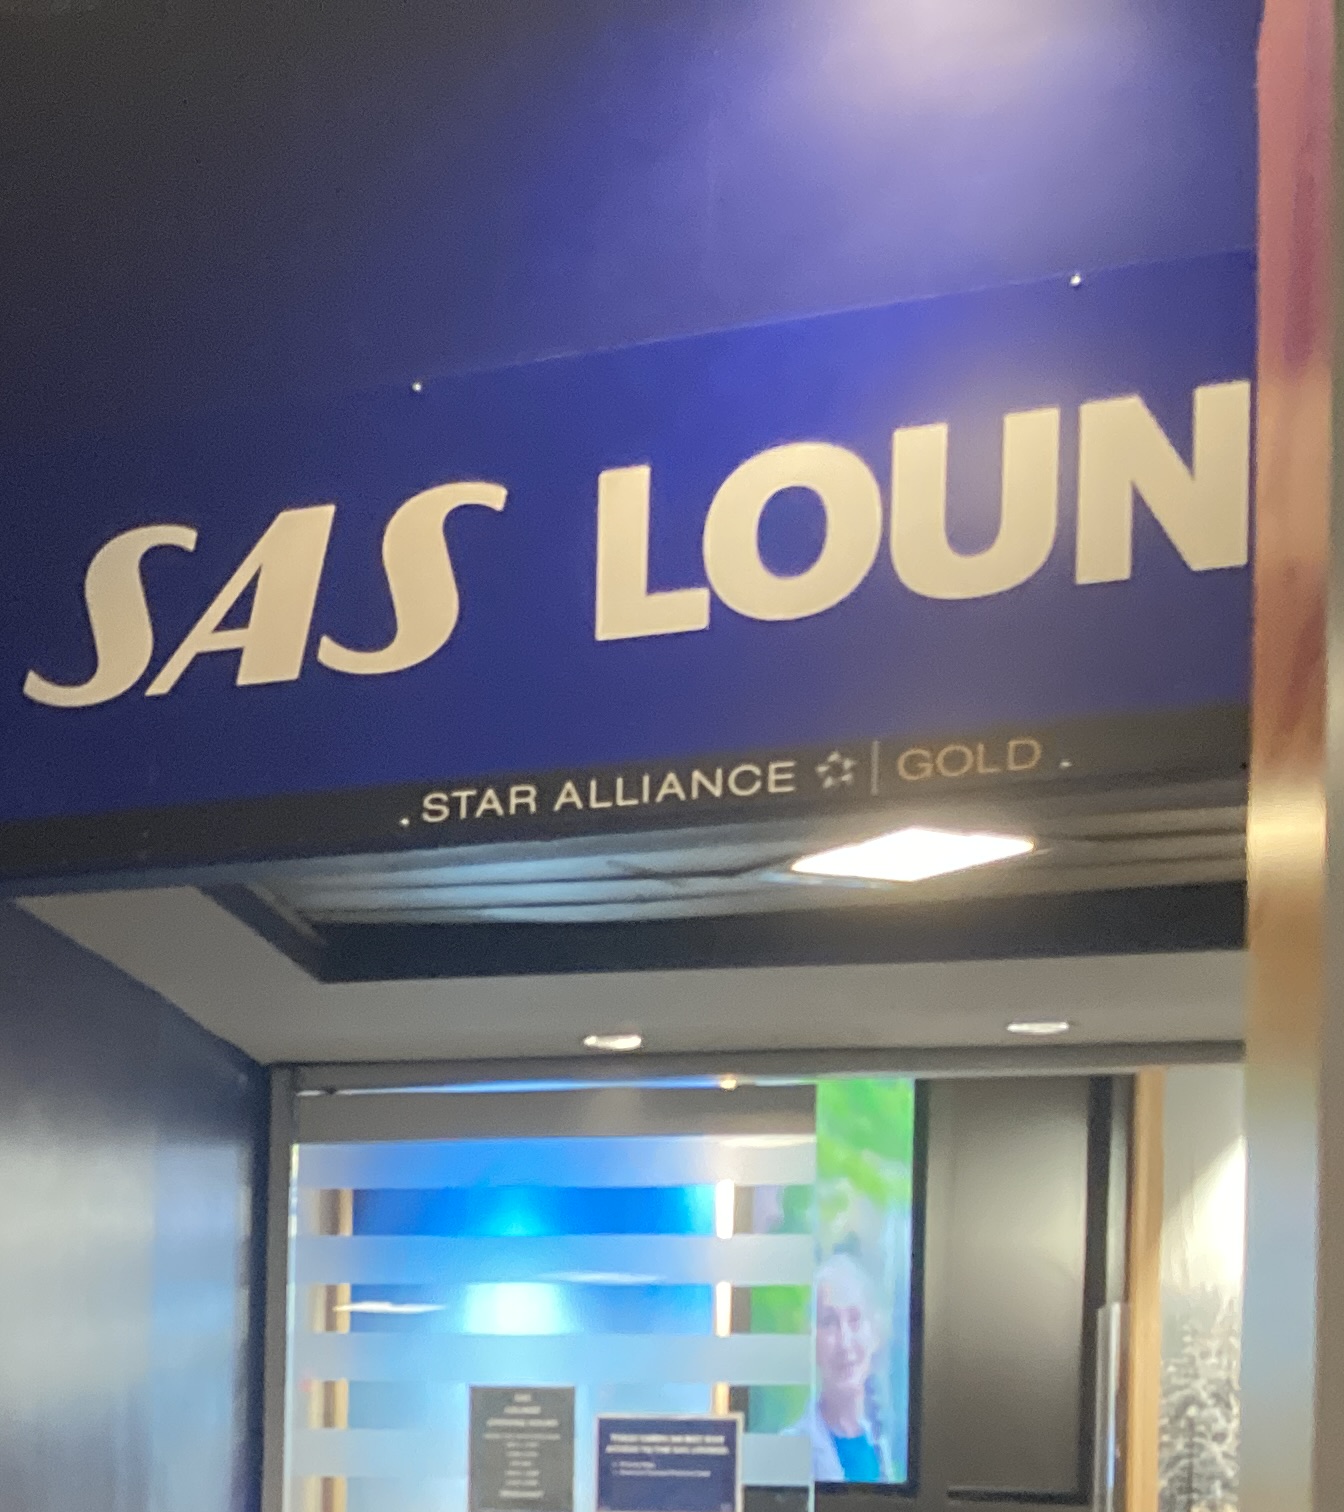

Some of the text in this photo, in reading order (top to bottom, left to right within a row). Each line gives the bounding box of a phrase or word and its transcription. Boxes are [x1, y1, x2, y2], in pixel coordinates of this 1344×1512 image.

[23, 481, 508, 709] SAS
[422, 738, 1043, 824] STAR ALLIANCE GOLD
